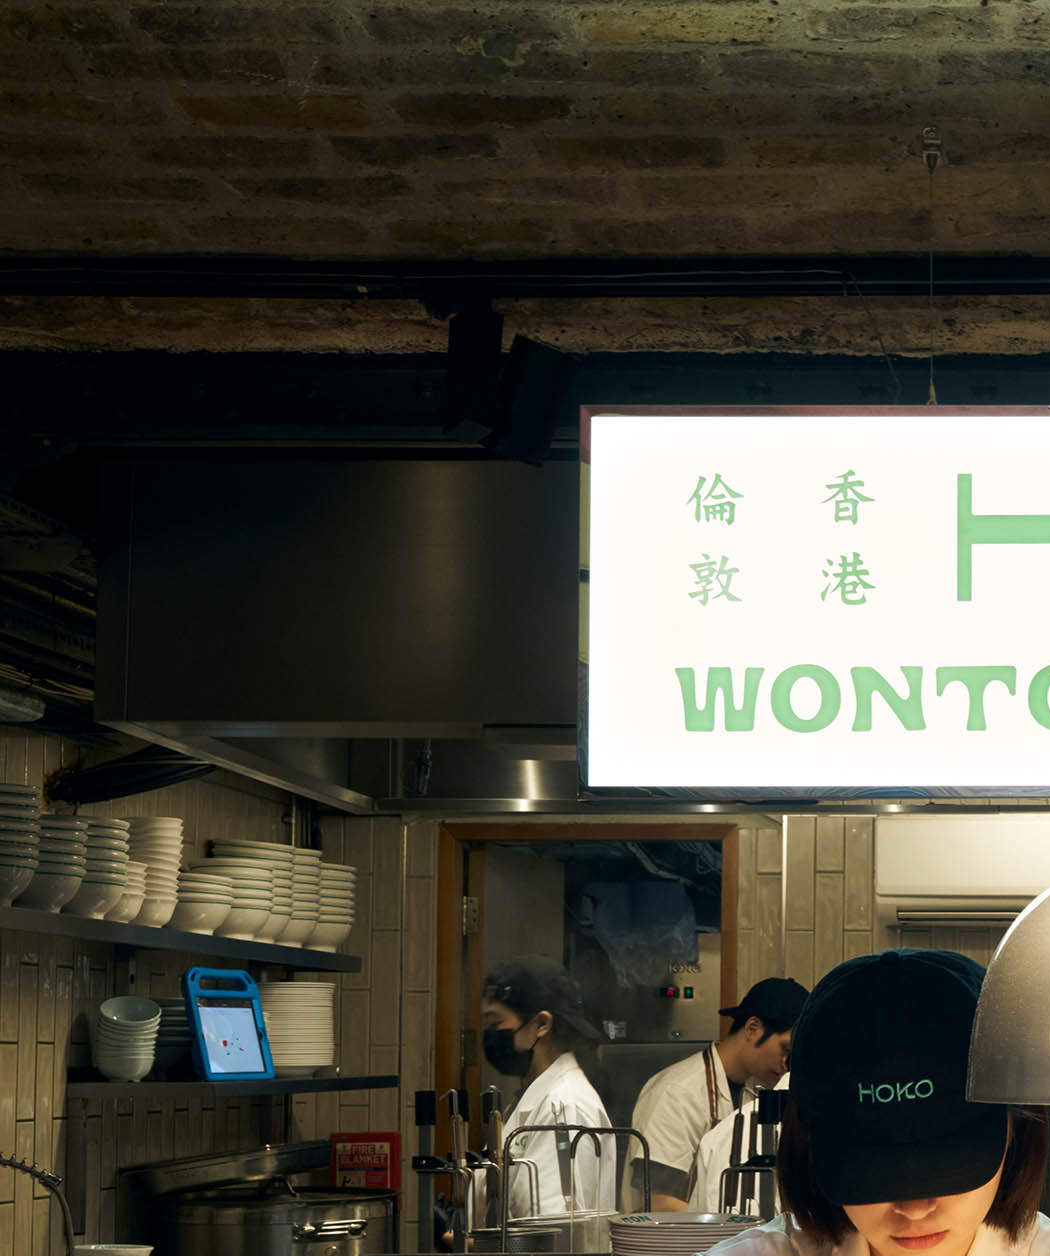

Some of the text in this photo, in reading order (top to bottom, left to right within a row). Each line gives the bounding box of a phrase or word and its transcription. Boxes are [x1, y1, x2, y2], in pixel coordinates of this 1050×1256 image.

[857, 1079, 934, 1103] HOKO
[351, 1144, 376, 1154] FIRE
[339, 1154, 388, 1165] BLANKET
